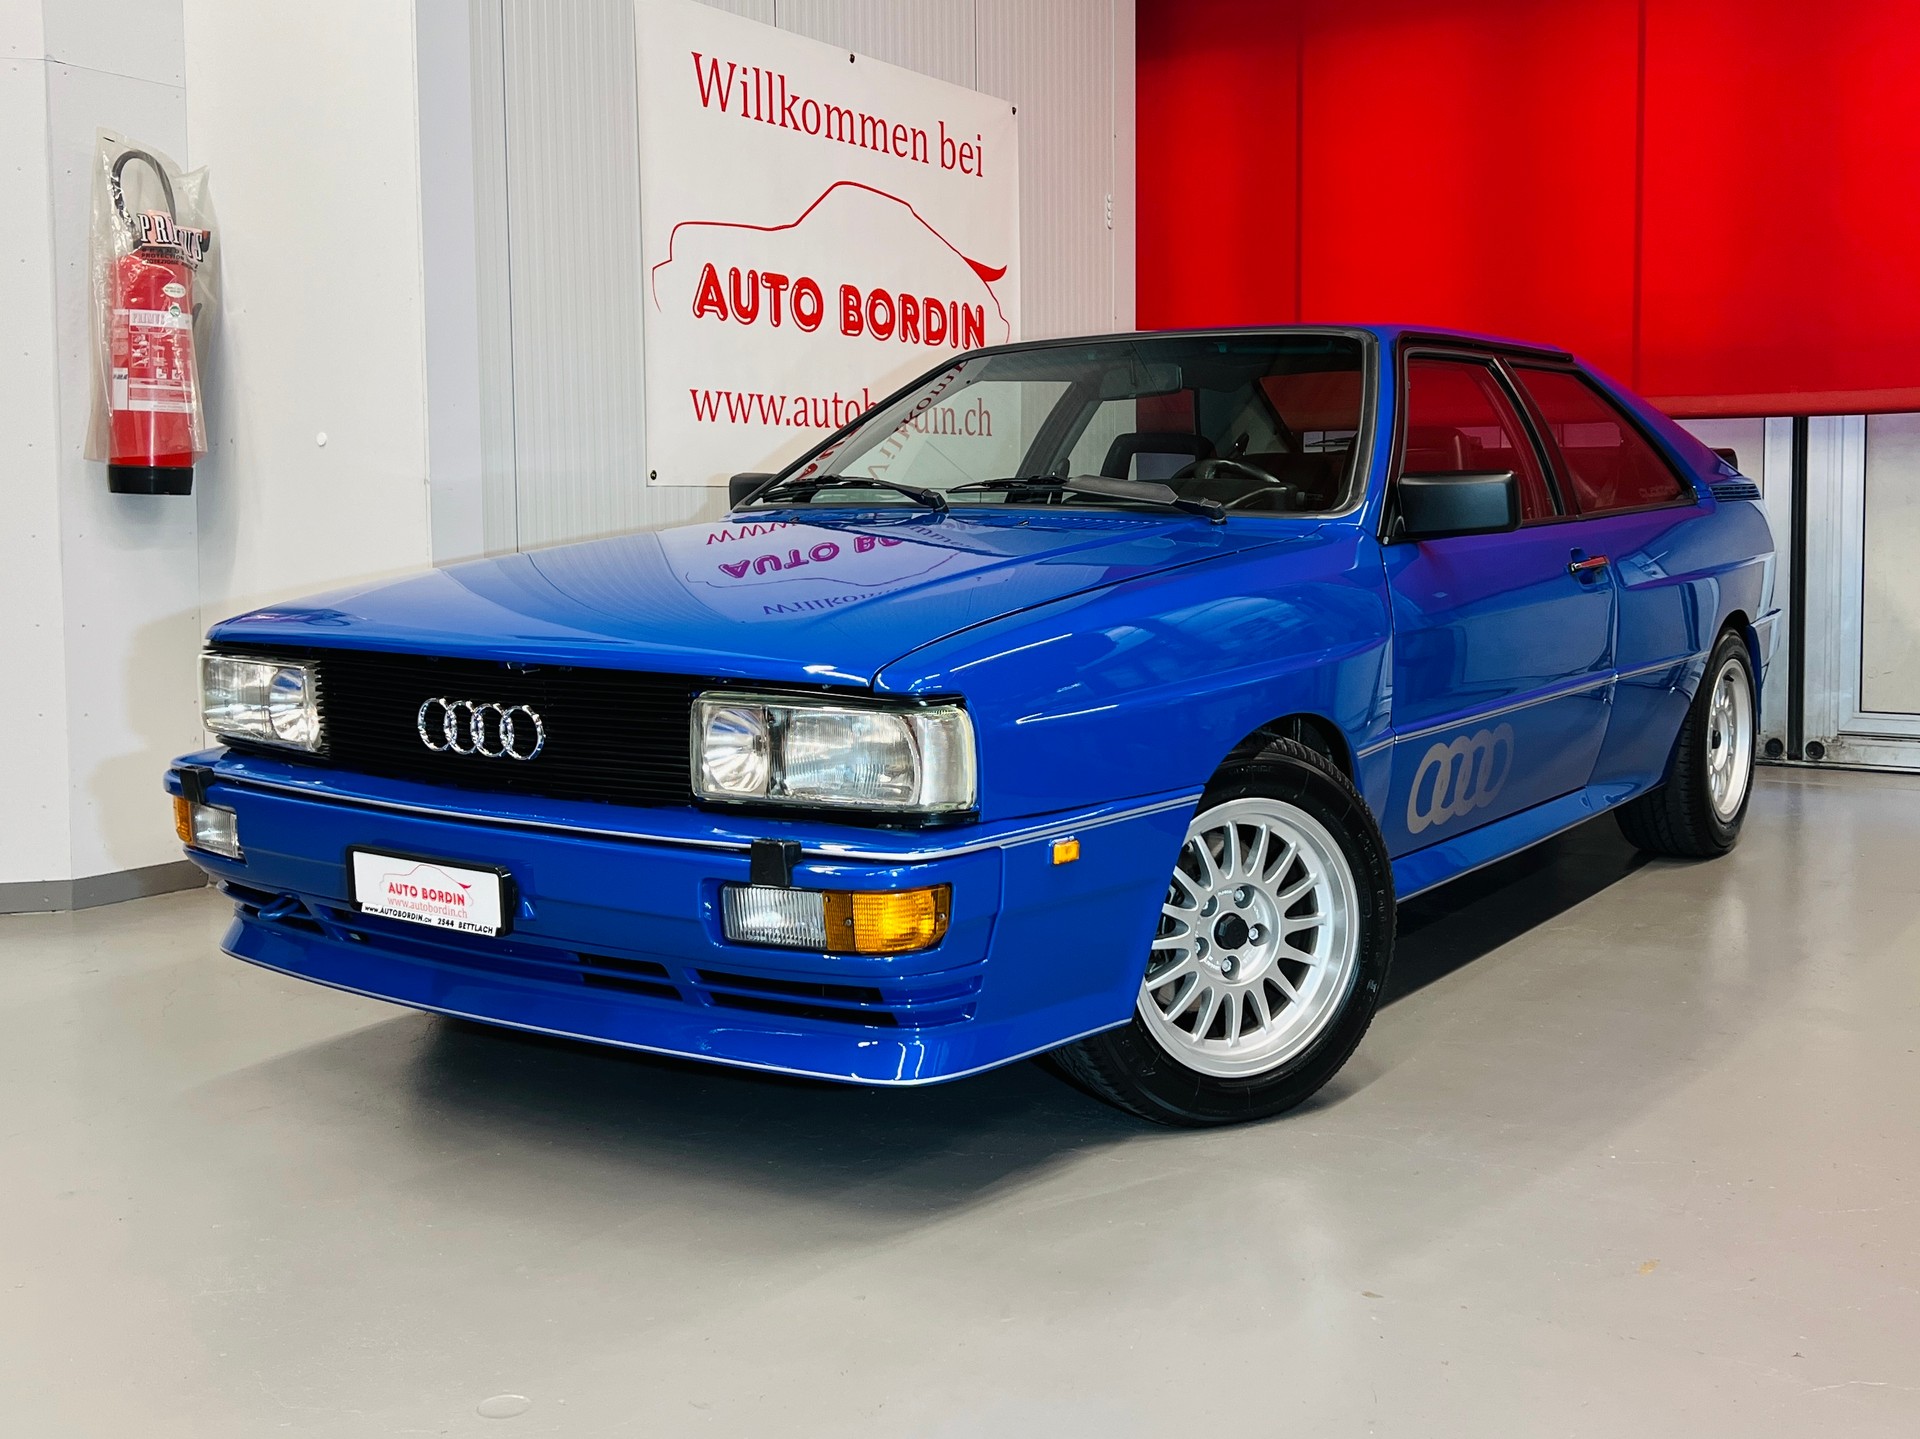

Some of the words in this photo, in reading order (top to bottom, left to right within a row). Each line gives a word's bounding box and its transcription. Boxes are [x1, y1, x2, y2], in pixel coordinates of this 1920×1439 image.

[691, 51, 930, 165] Willkommen
[938, 120, 984, 178] bei
[692, 262, 824, 333] AUTO
[839, 283, 985, 349] BORDIN
[388, 881, 418, 898] AUTO
[422, 887, 465, 906] BORDIN
[387, 896, 468, 919] www.autobordin.ch
[437, 917, 455, 928] 2544
[458, 921, 493, 935] BETTLACH
